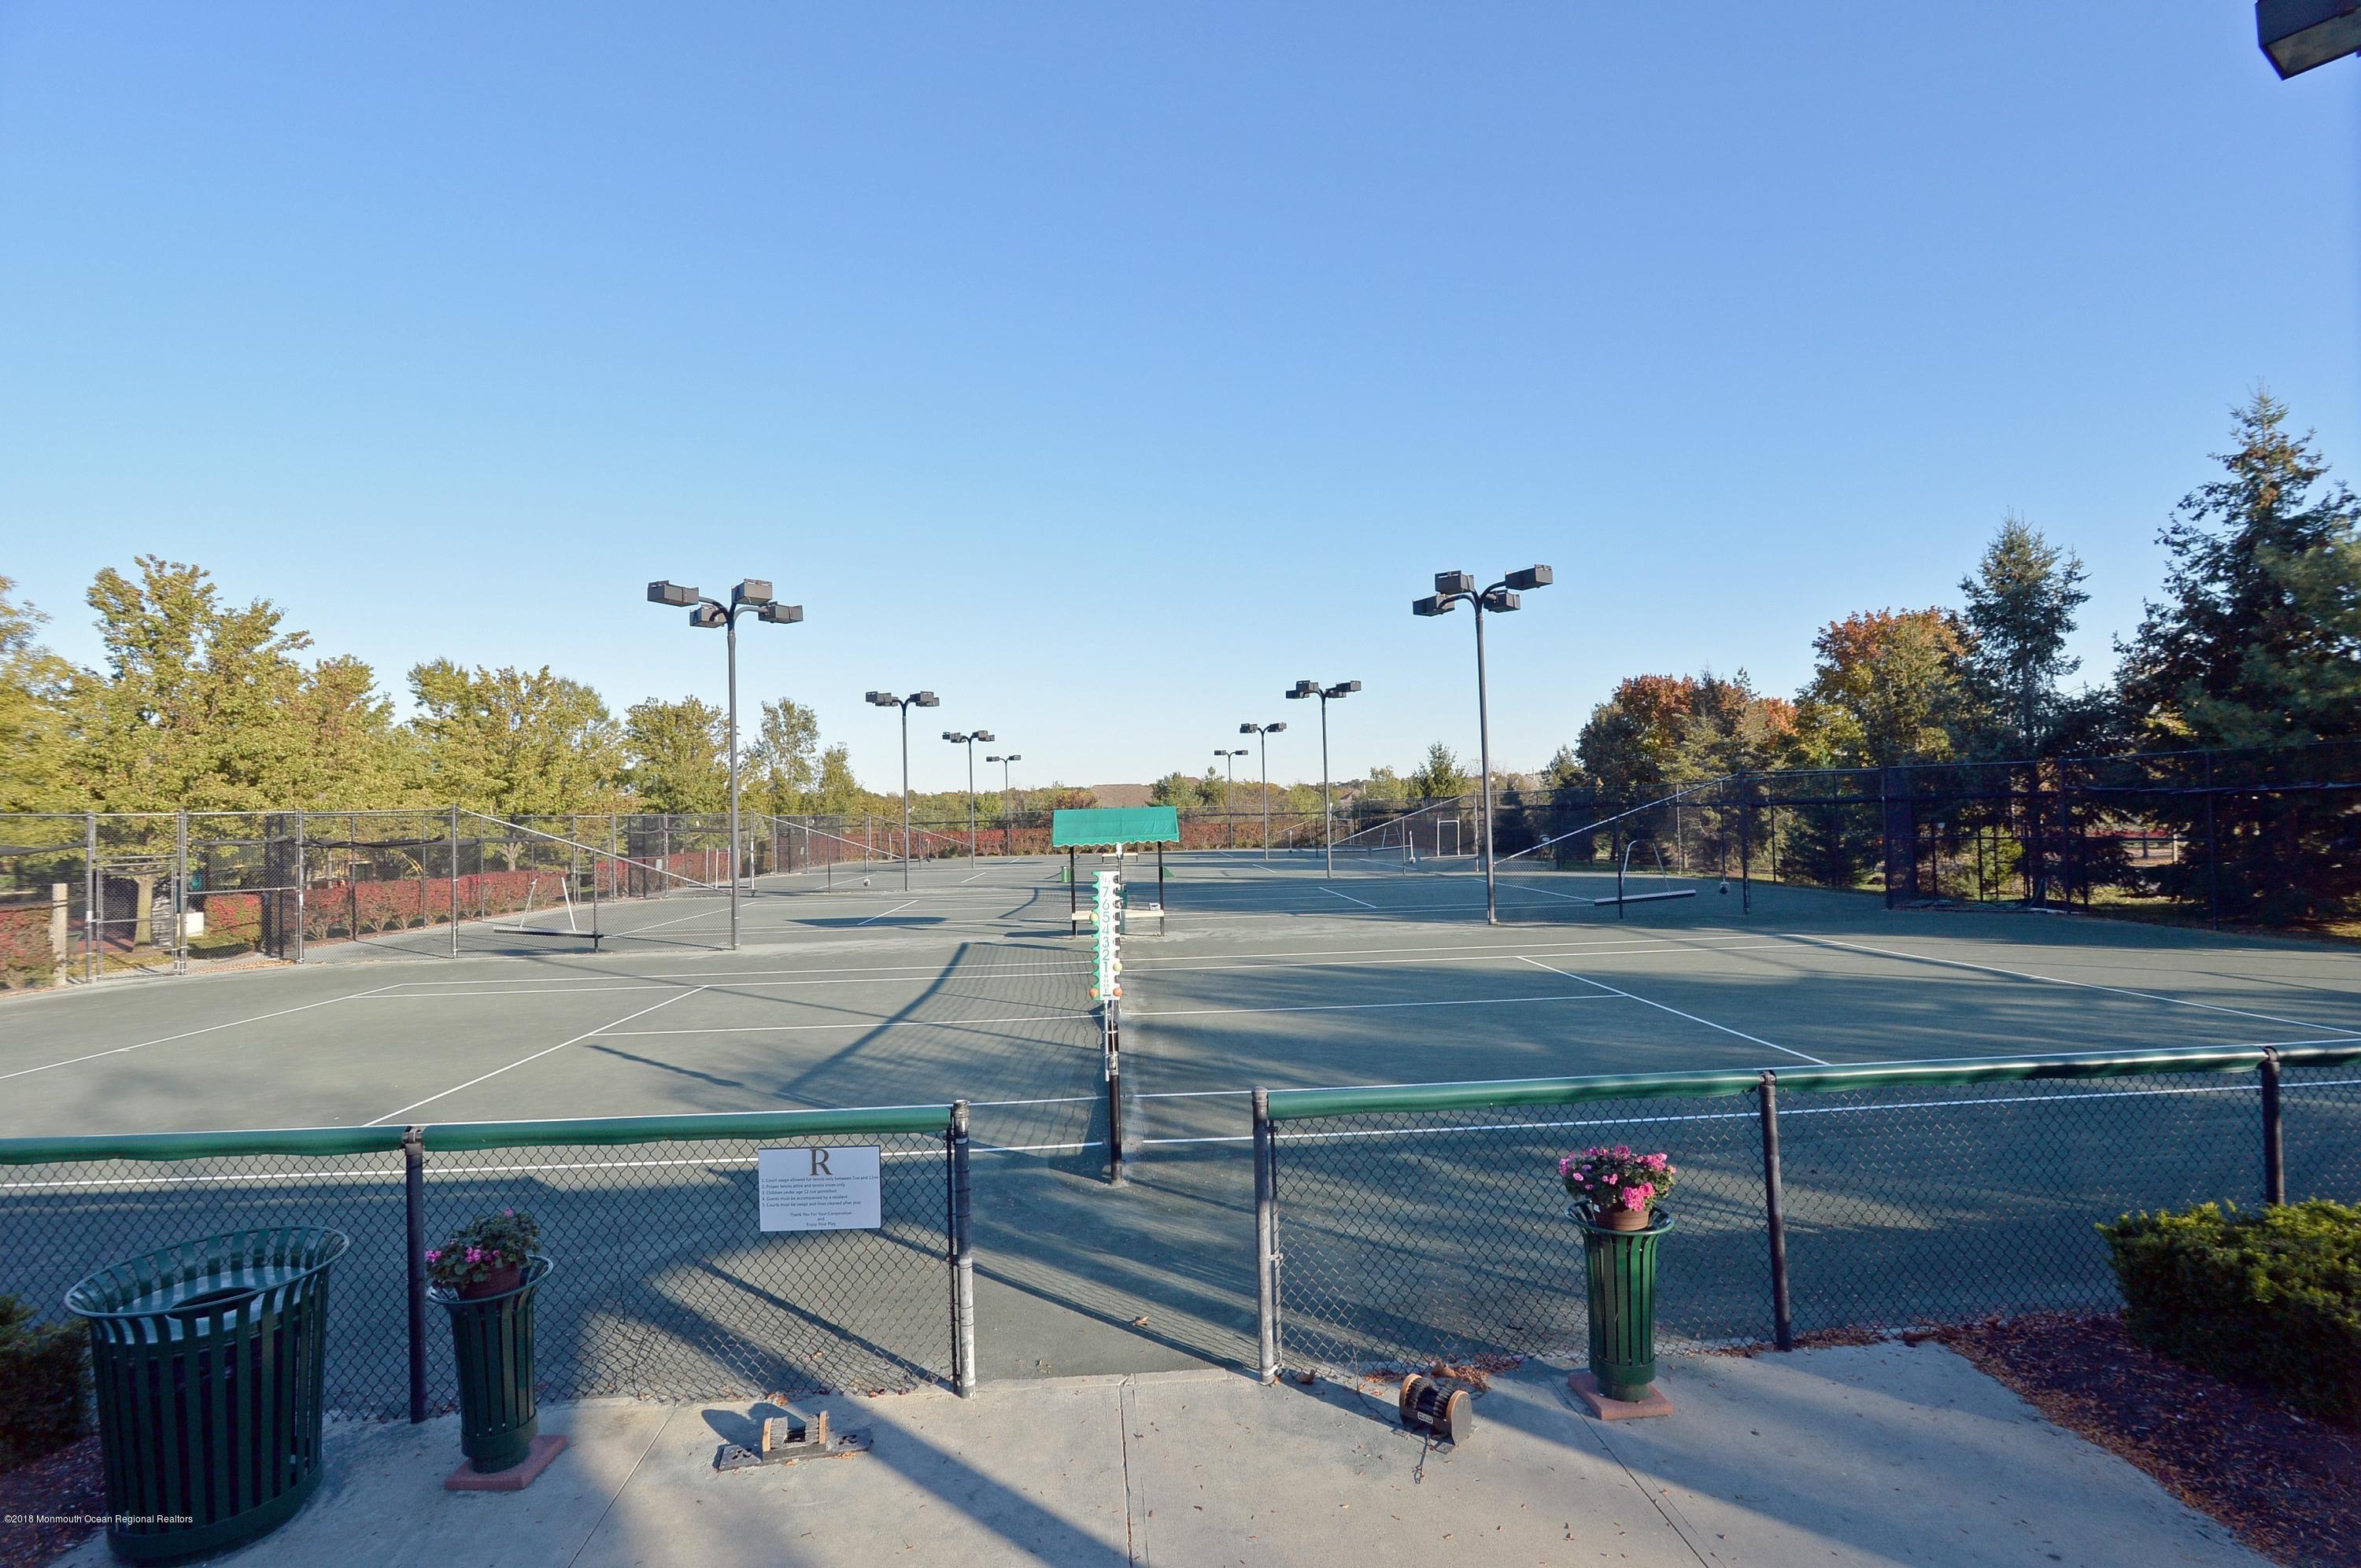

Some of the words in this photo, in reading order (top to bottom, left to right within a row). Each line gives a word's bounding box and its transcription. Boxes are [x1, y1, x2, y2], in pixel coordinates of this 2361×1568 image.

[1102, 886, 1109, 898] 7
[1102, 899, 1110, 910] 6
[1102, 911, 1110, 923] 5
[1102, 924, 1110, 935] 4
[1103, 936, 1110, 948] 3
[1103, 949, 1110, 961] 2
[1103, 961, 1107, 972] 1
[809, 1149, 833, 1175] R
